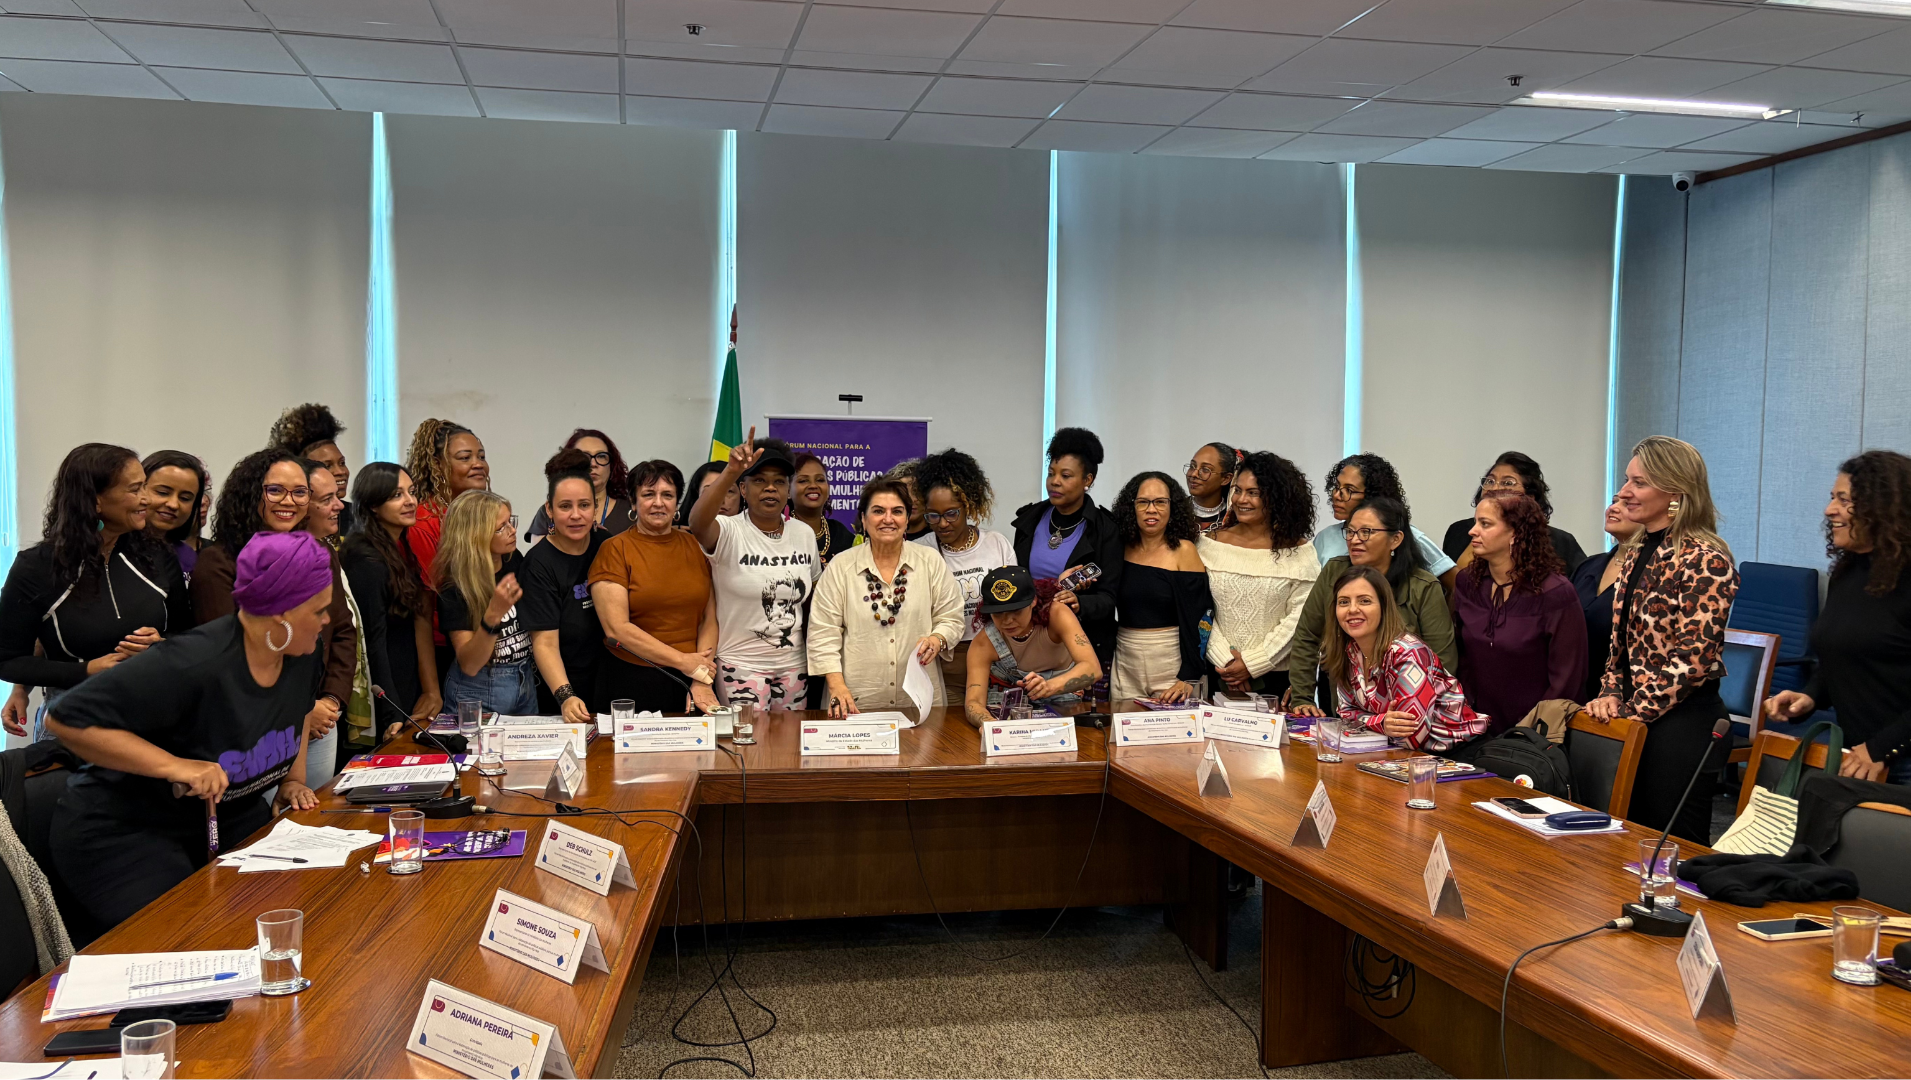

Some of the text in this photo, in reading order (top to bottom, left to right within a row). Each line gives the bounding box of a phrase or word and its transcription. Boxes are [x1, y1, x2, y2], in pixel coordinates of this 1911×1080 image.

[784, 441, 805, 449] ÓRUM
[816, 456, 865, 468] AÇÃO DE
[739, 550, 812, 566] ANASTÁCIA
[517, 918, 557, 939] SIMONE SOUZA
[450, 1008, 514, 1040] ADRIANA PEREIRA
